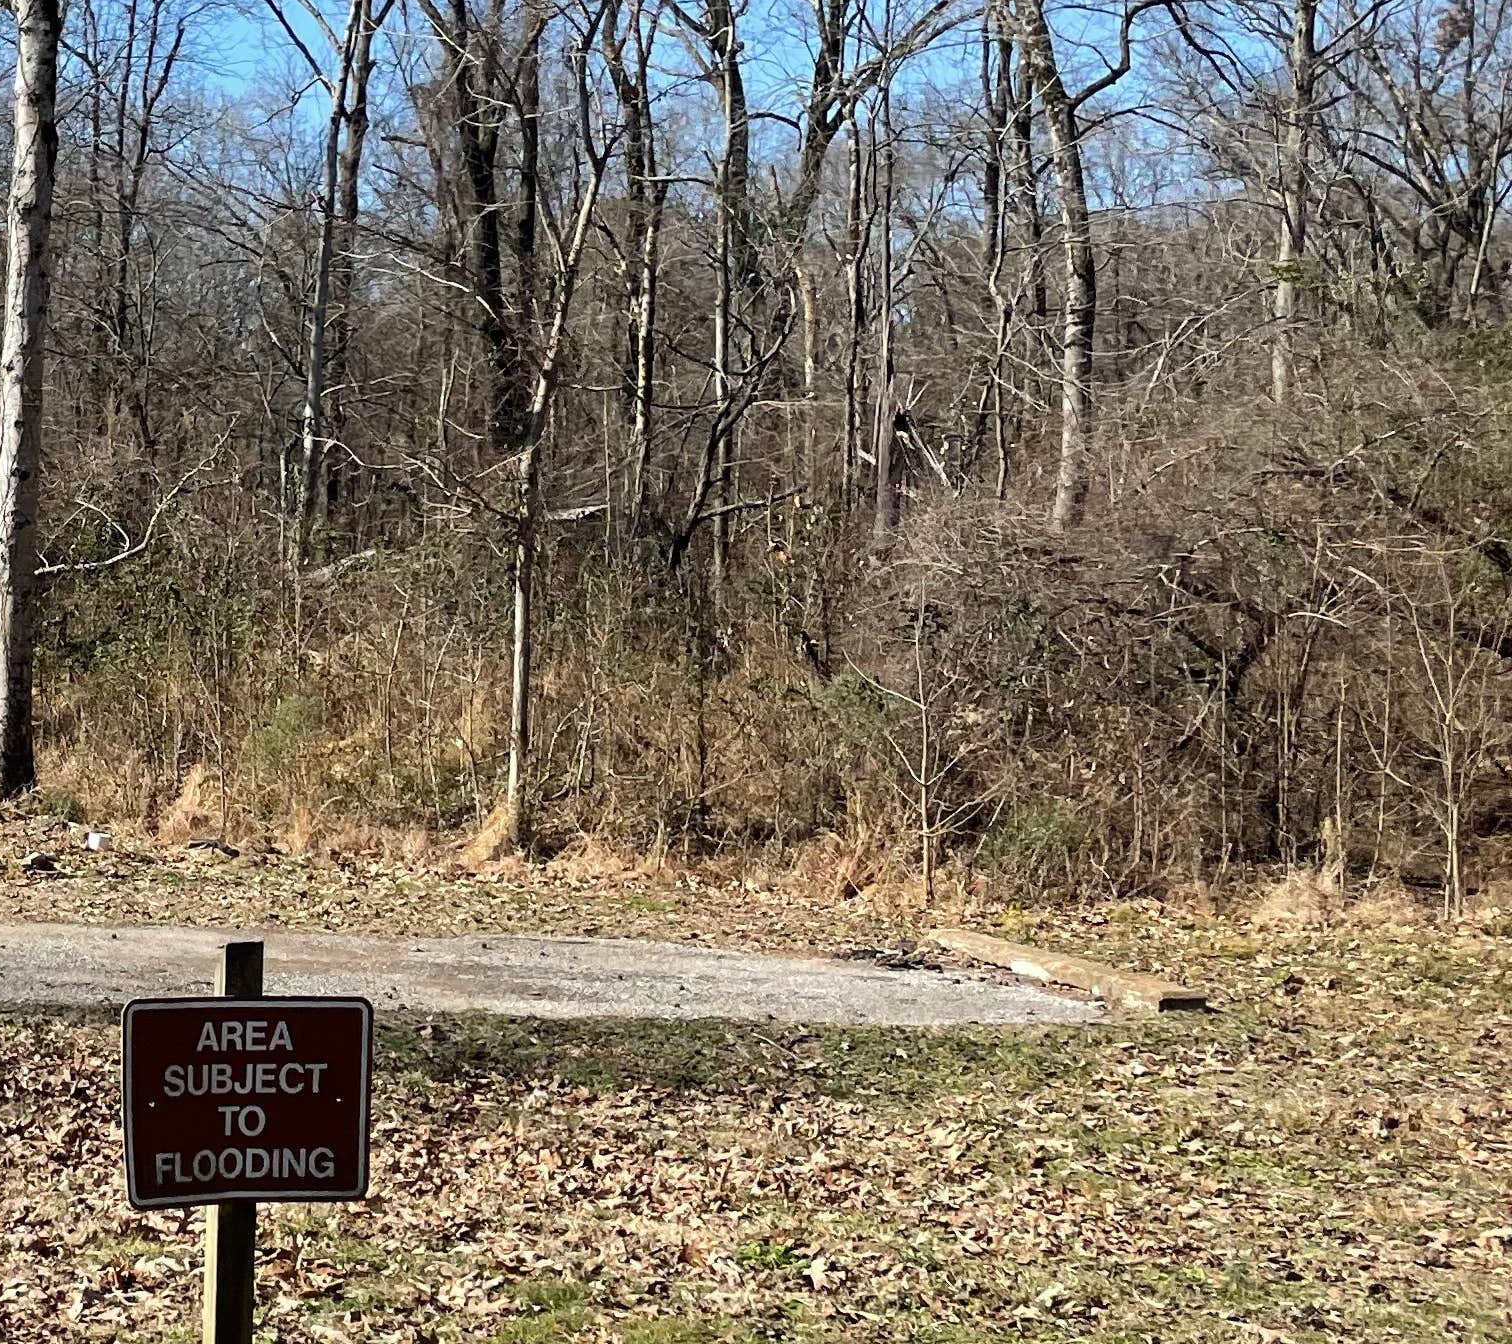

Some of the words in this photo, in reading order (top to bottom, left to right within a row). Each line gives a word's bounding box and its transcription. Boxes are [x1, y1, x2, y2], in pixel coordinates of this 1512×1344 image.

[196, 1020, 294, 1052] AREA
[163, 1062, 328, 1097] SUBJECT
[217, 1105, 266, 1137] TO
[155, 1146, 336, 1185] FLOODING
